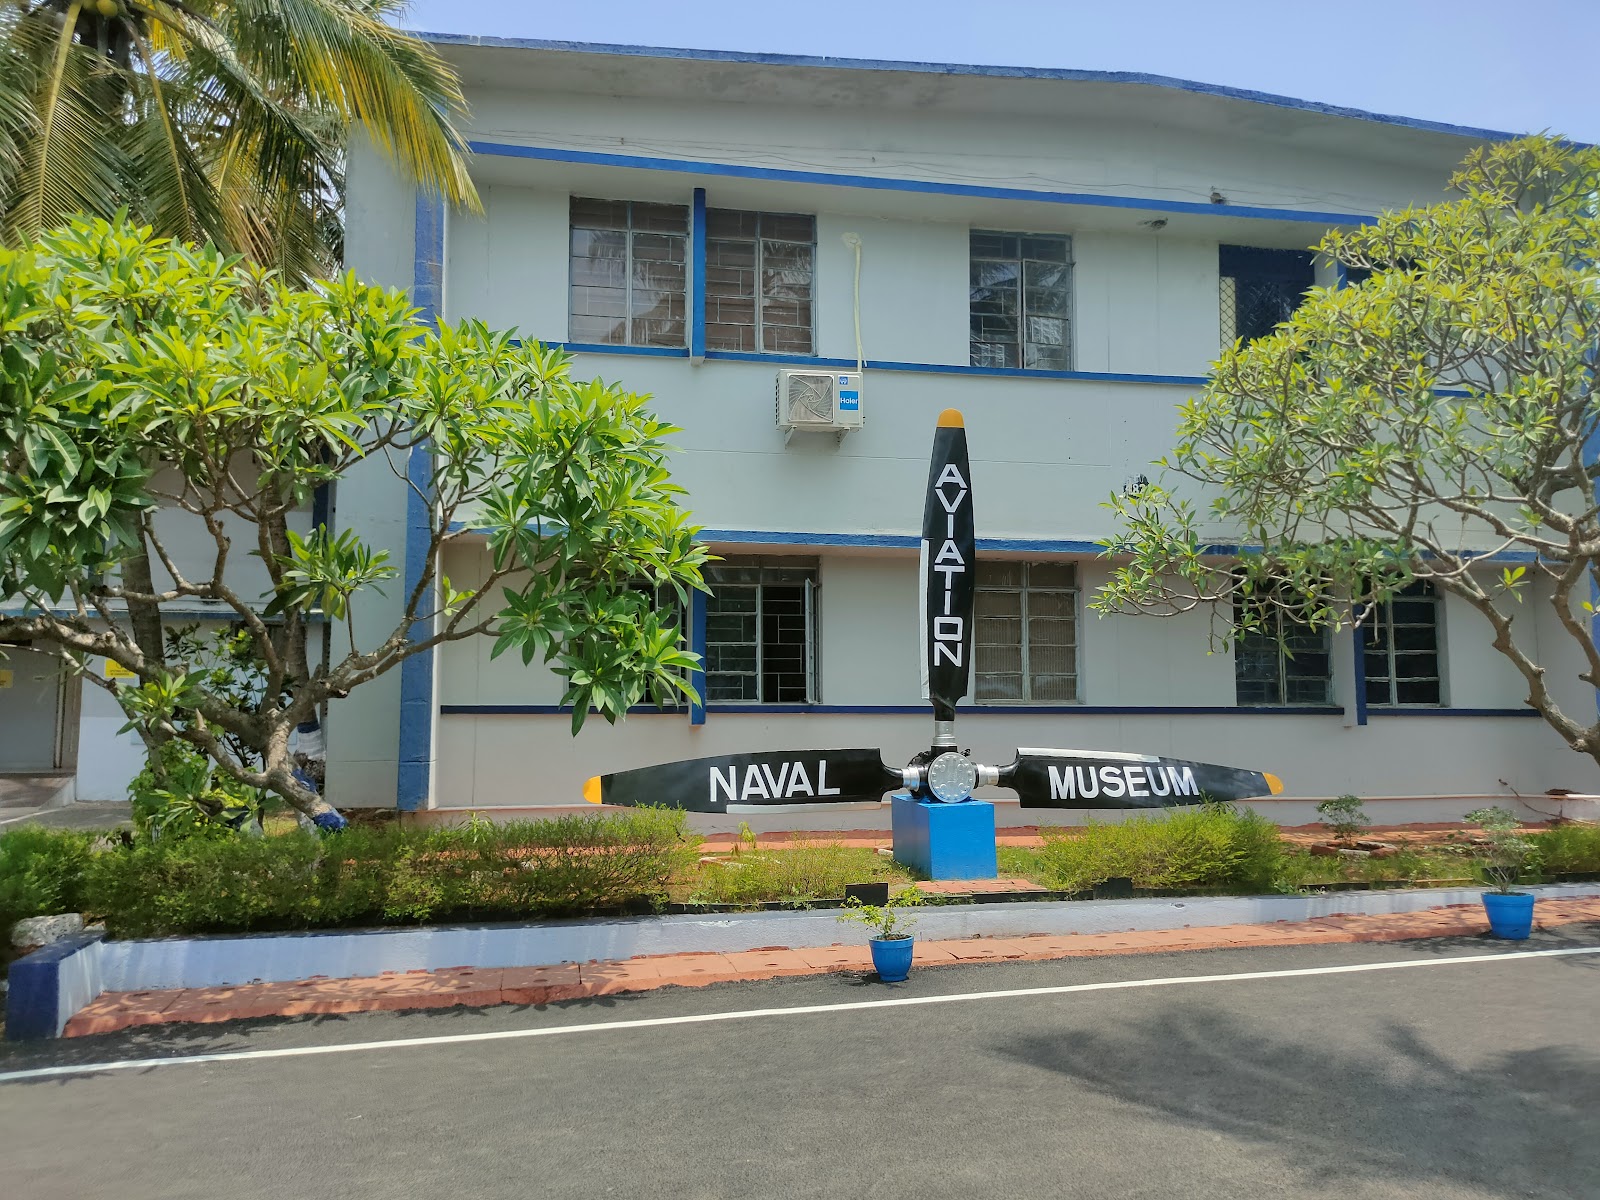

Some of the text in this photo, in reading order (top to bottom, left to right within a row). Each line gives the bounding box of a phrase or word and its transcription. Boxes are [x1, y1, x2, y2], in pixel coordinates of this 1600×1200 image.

[934, 463, 968, 667] AVIATION
[709, 759, 841, 802] NAVAL
[1047, 765, 1200, 800] MUSEUM
